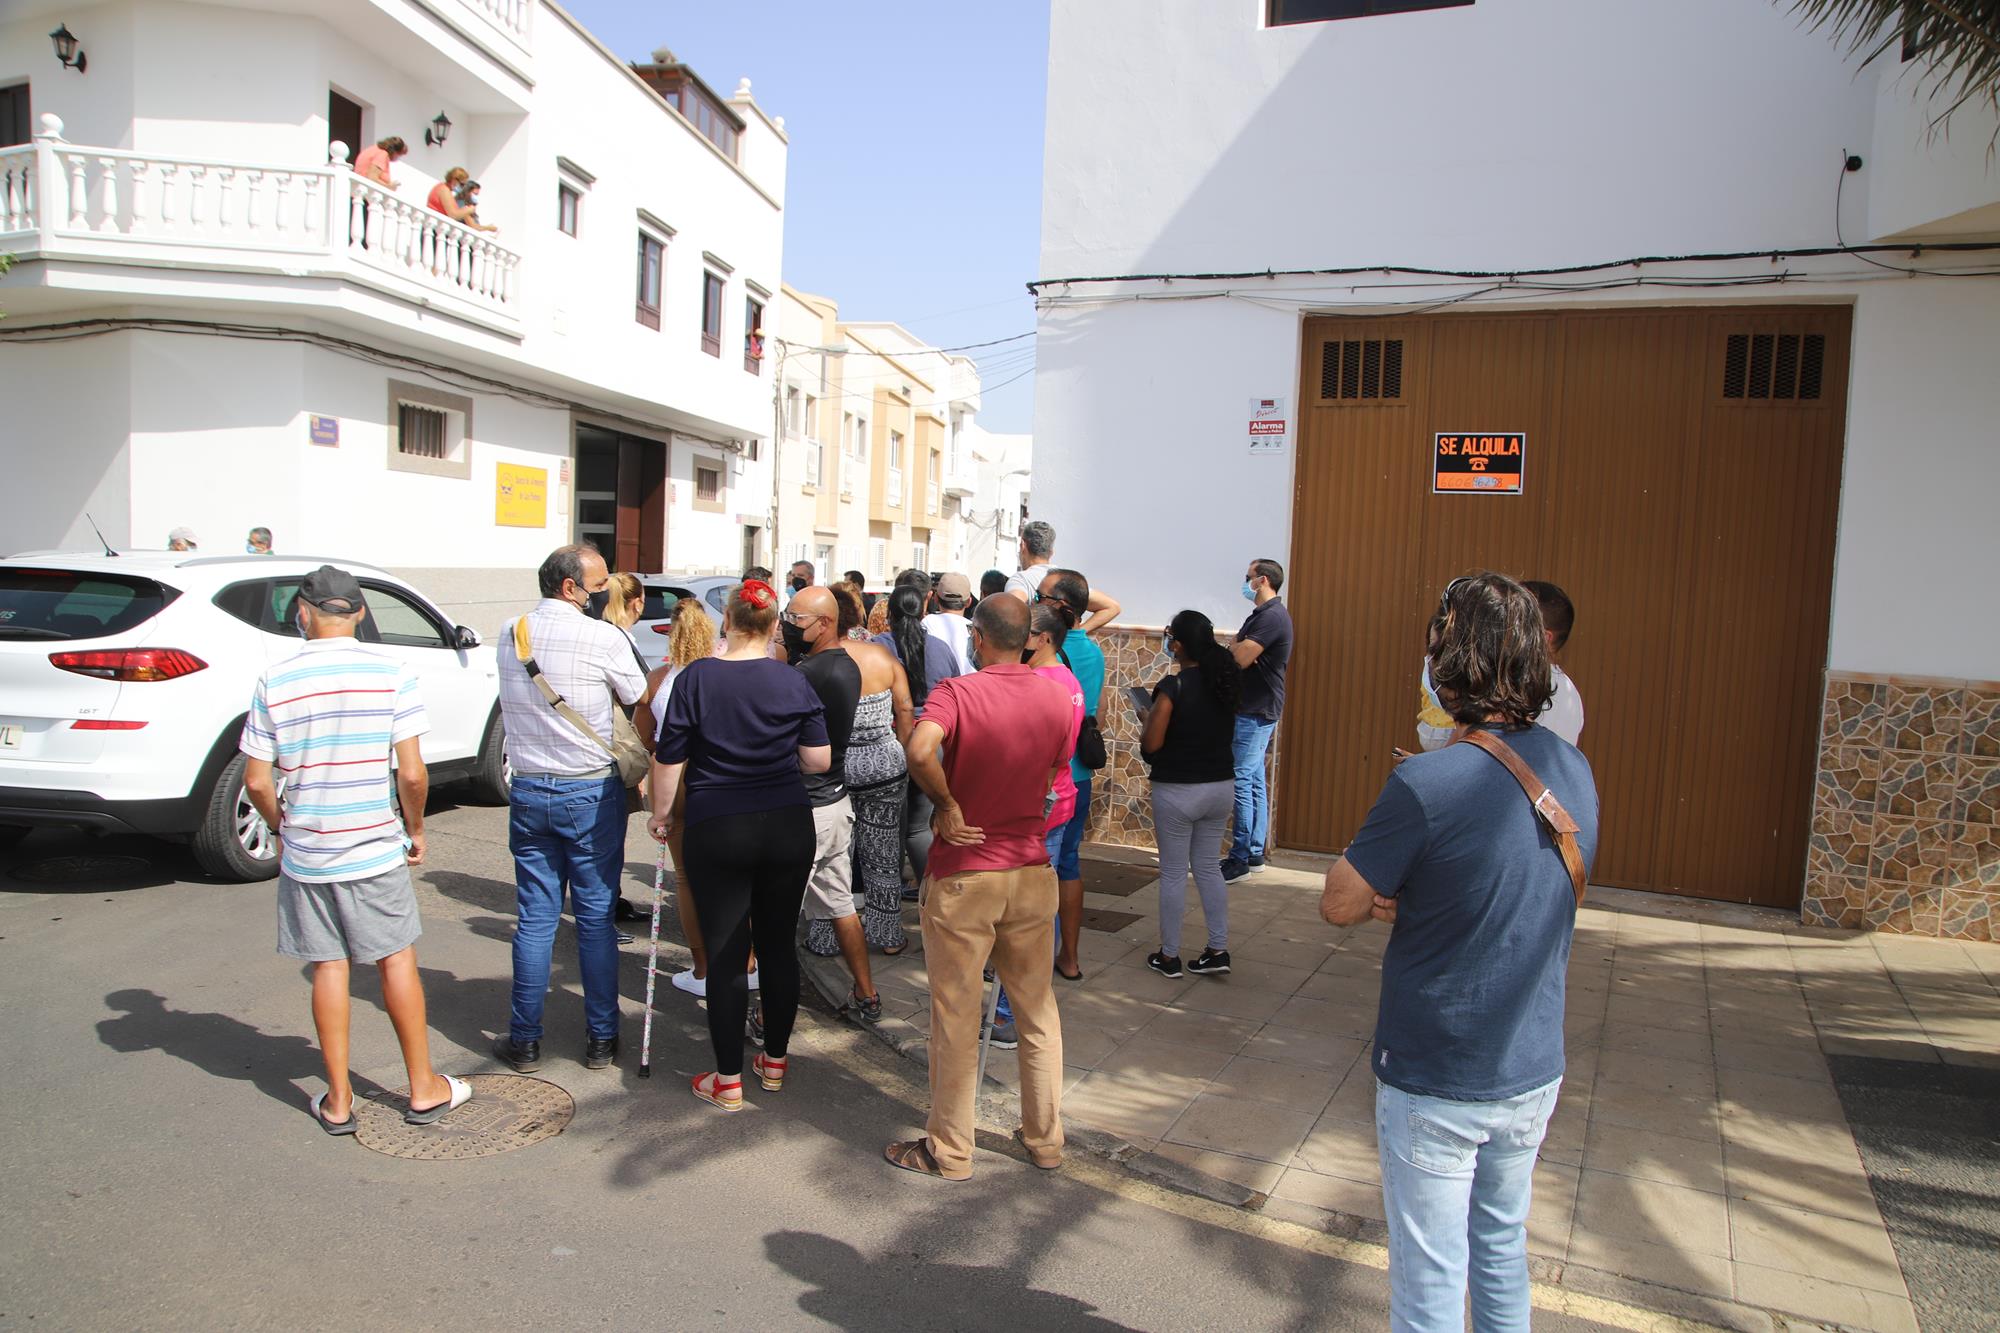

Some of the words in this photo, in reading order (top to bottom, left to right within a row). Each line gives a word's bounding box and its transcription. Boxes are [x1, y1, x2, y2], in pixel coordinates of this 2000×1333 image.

[1251, 422, 1283, 430] Alarma
[1439, 437, 1458, 455] SE
[1461, 437, 1520, 456] ALQUILA
